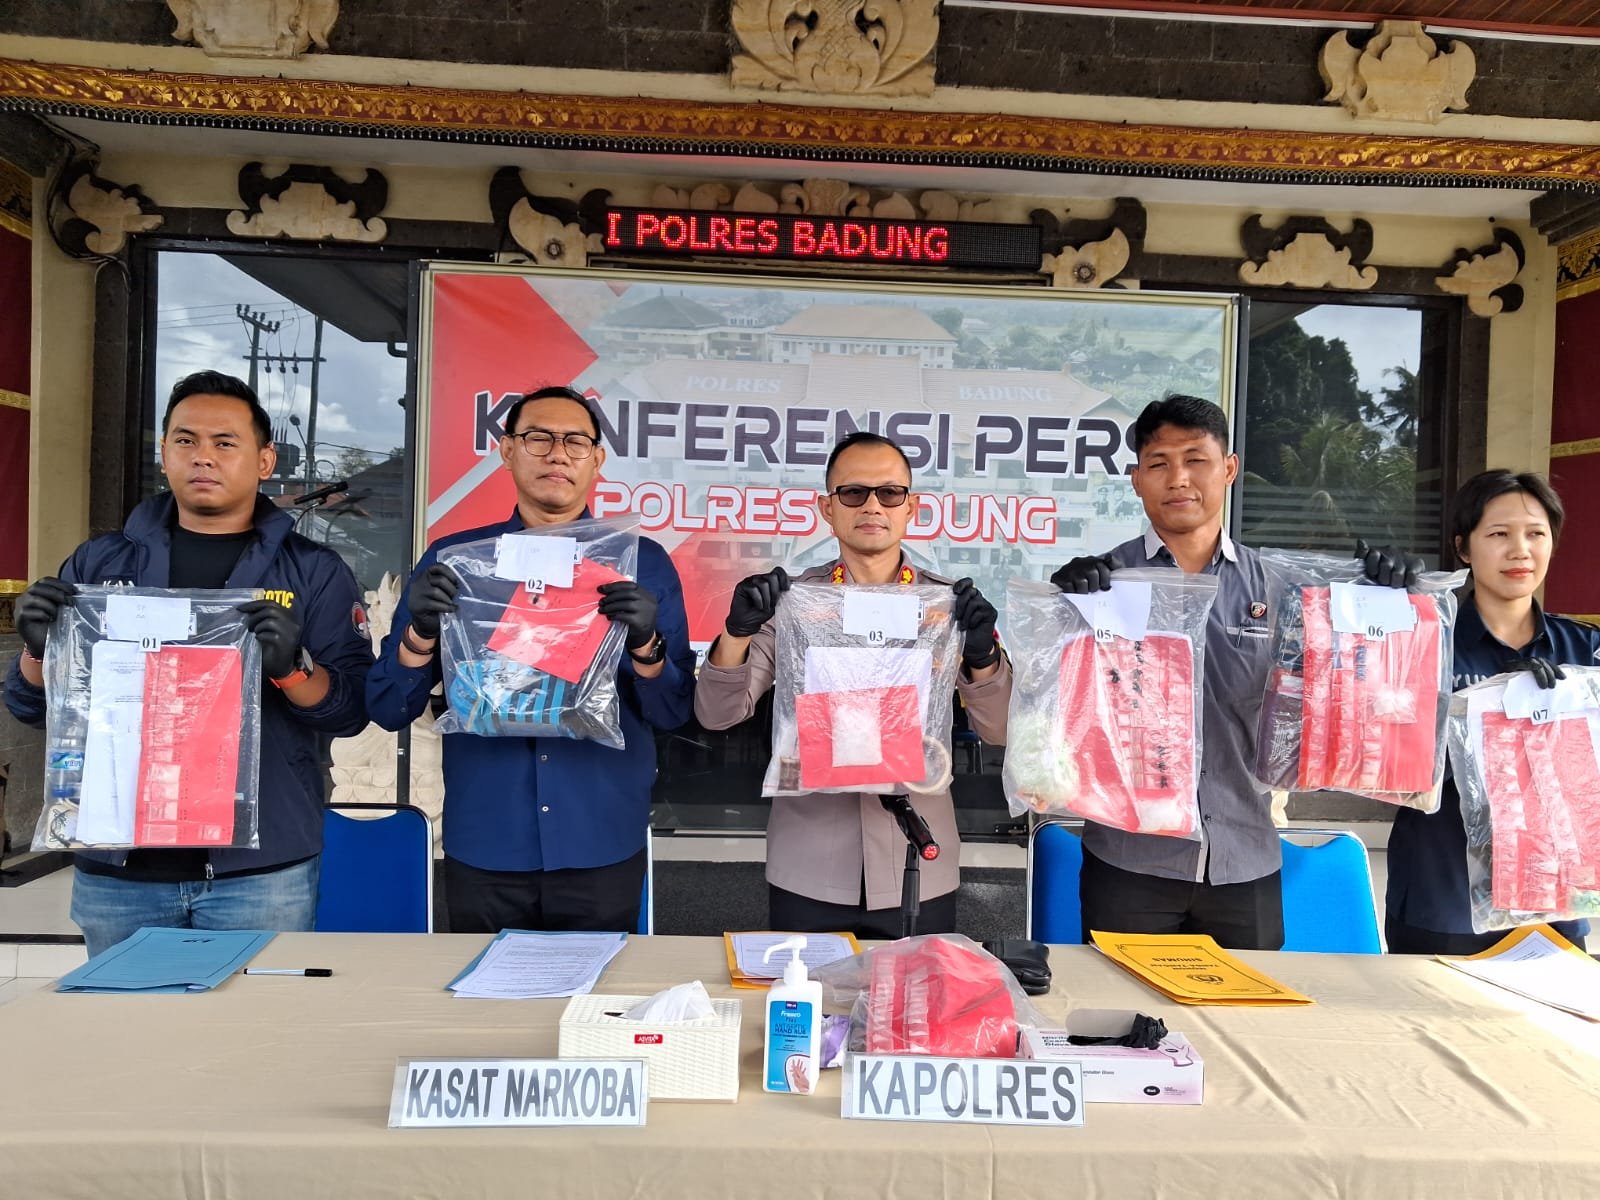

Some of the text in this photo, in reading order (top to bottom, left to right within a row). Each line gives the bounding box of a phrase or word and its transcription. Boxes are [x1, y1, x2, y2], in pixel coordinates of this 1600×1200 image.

[637, 213, 779, 253] POLRES
[793, 221, 949, 261] BADUNG
[686, 375, 1052, 402] POLRES BADUNG
[474, 390, 951, 472] KNFERENSI
[594, 481, 1057, 544] POLRES DUNG
[527, 579, 543, 590] 02
[869, 630, 883, 642] 03
[1096, 629, 1112, 640] 05
[1367, 625, 1384, 638] 06
[142, 637, 157, 649] 01
[1532, 709, 1549, 722] 07
[406, 1066, 637, 1119] KASAT NARKOBA
[858, 1058, 1077, 1123] KAPOLRES
